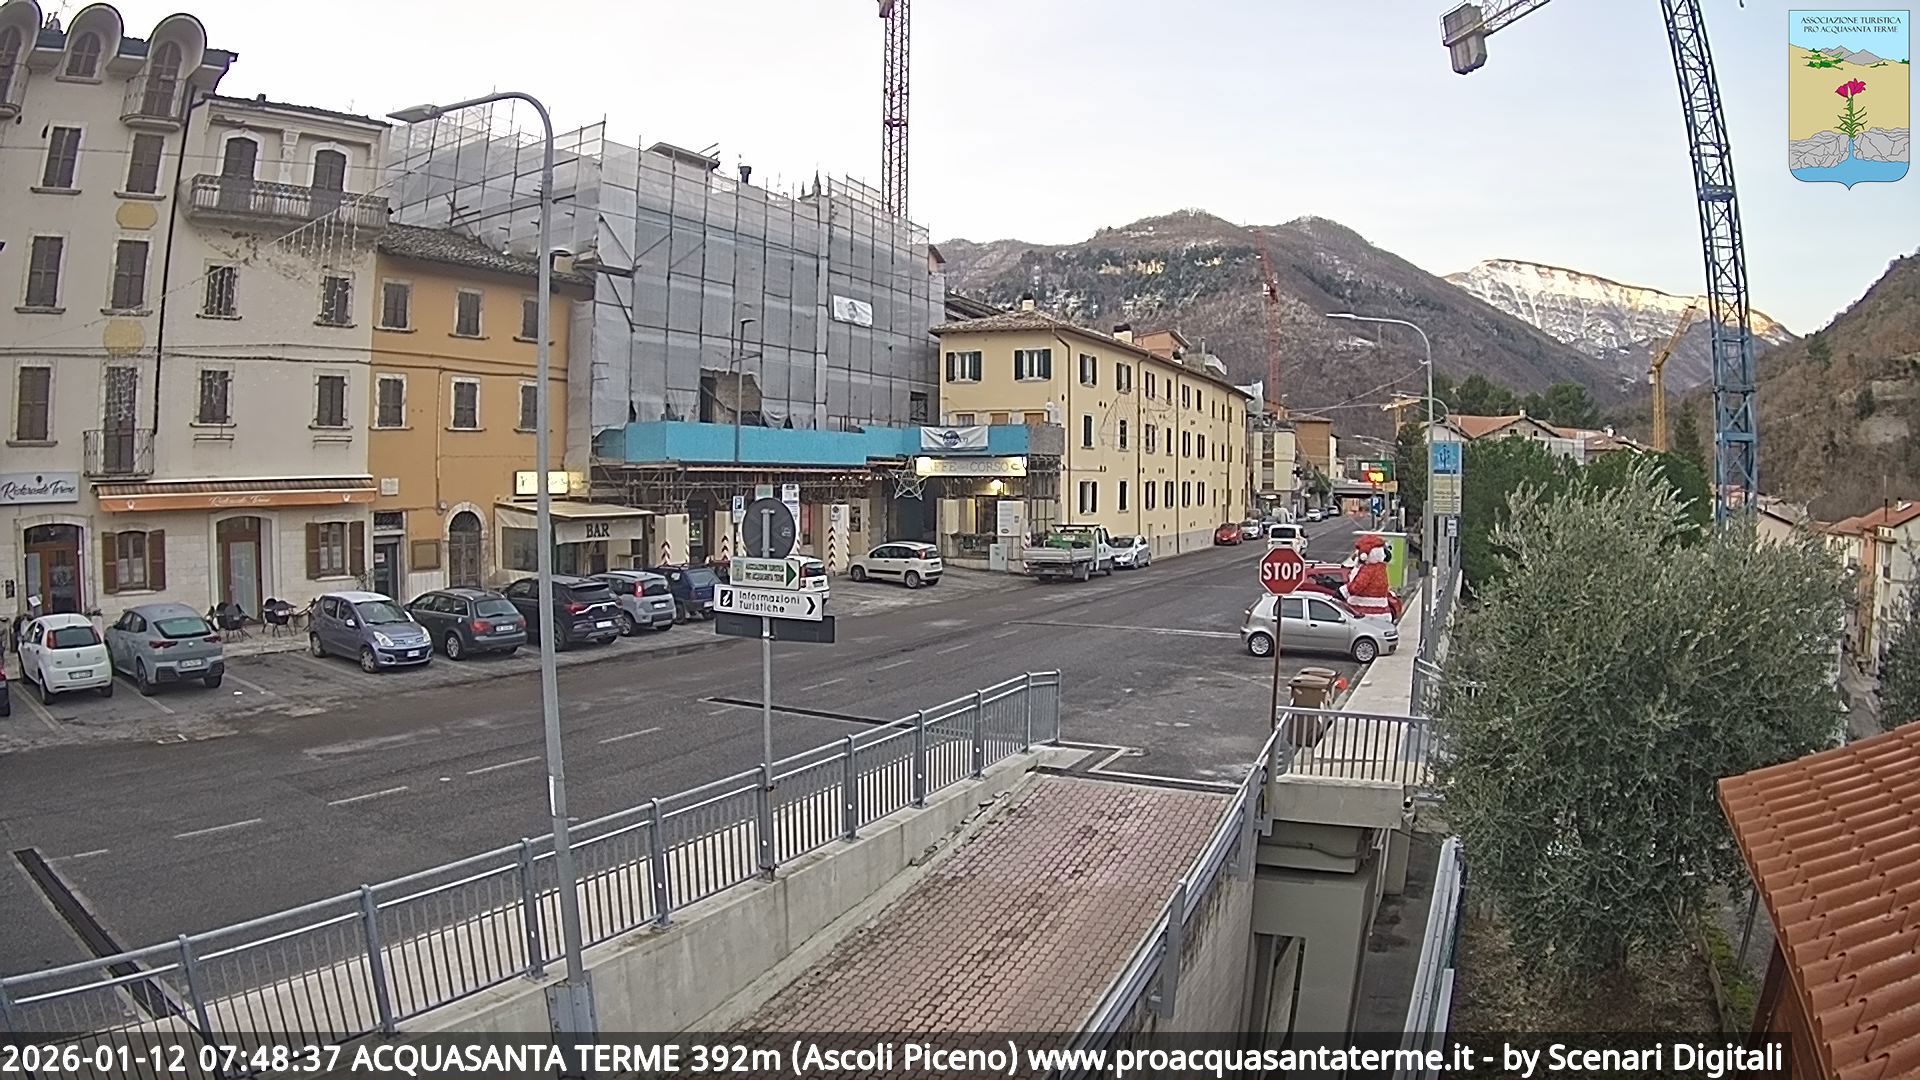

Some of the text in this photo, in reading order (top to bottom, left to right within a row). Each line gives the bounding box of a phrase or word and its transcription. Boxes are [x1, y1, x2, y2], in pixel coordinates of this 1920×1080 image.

[970, 461, 1008, 472] CORSO
[586, 523, 610, 538] BAR
[1263, 562, 1302, 580] STOP
[739, 590, 800, 605] Informazioni
[739, 600, 785, 614] Turistiche
